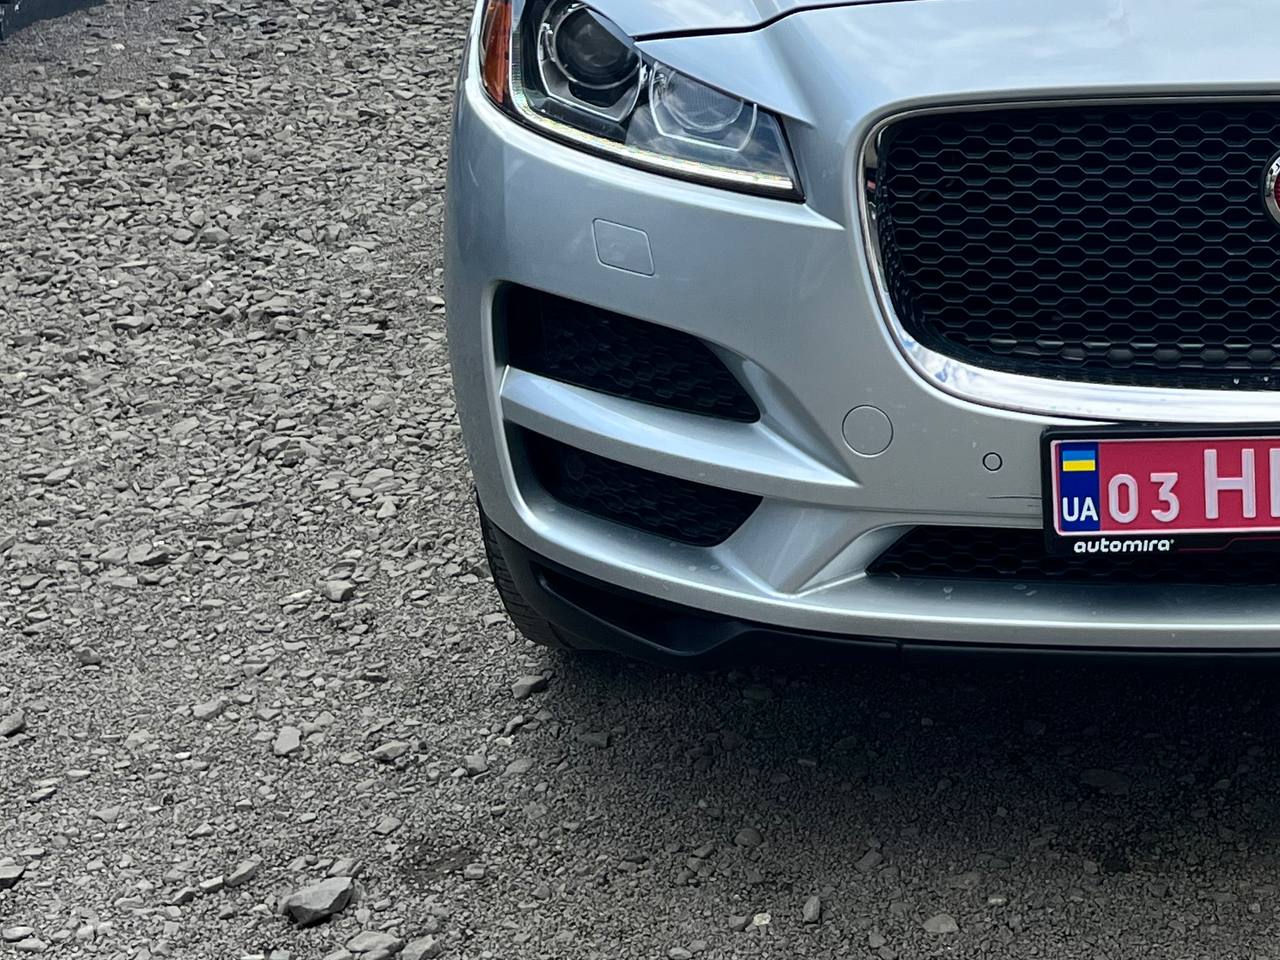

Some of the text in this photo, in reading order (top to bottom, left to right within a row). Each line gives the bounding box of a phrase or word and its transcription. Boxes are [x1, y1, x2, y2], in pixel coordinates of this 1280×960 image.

[1062, 496, 1099, 522] UA
[1107, 472, 1181, 524] 03
[1073, 538, 1172, 554] automira
